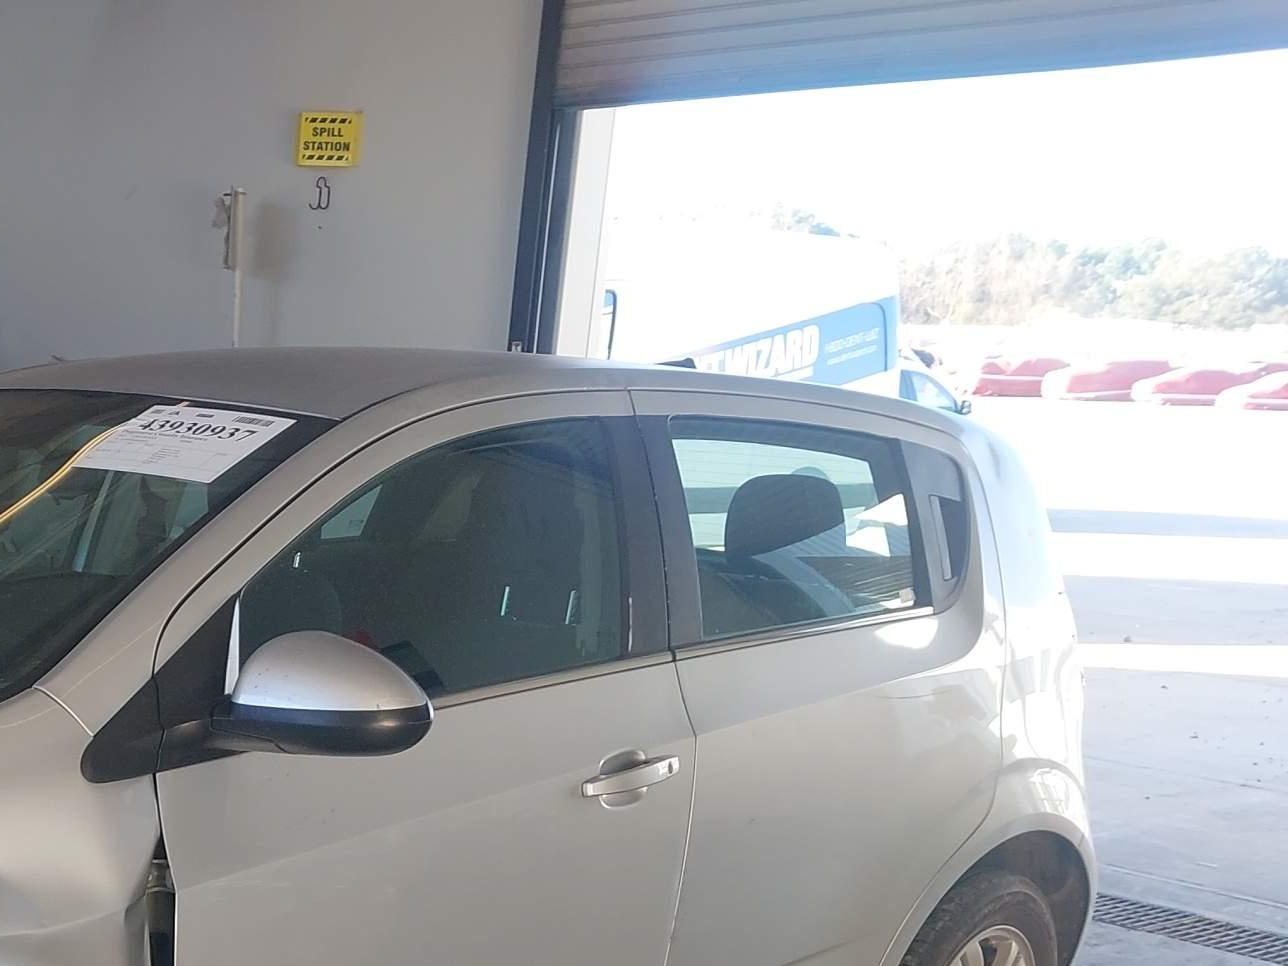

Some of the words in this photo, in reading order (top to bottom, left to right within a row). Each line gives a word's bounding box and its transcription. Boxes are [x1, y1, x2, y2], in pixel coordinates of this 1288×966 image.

[312, 127, 344, 137] SPILL
[303, 141, 351, 151] STATION
[725, 324, 820, 377] WIZARD
[138, 418, 258, 442] 43930937
